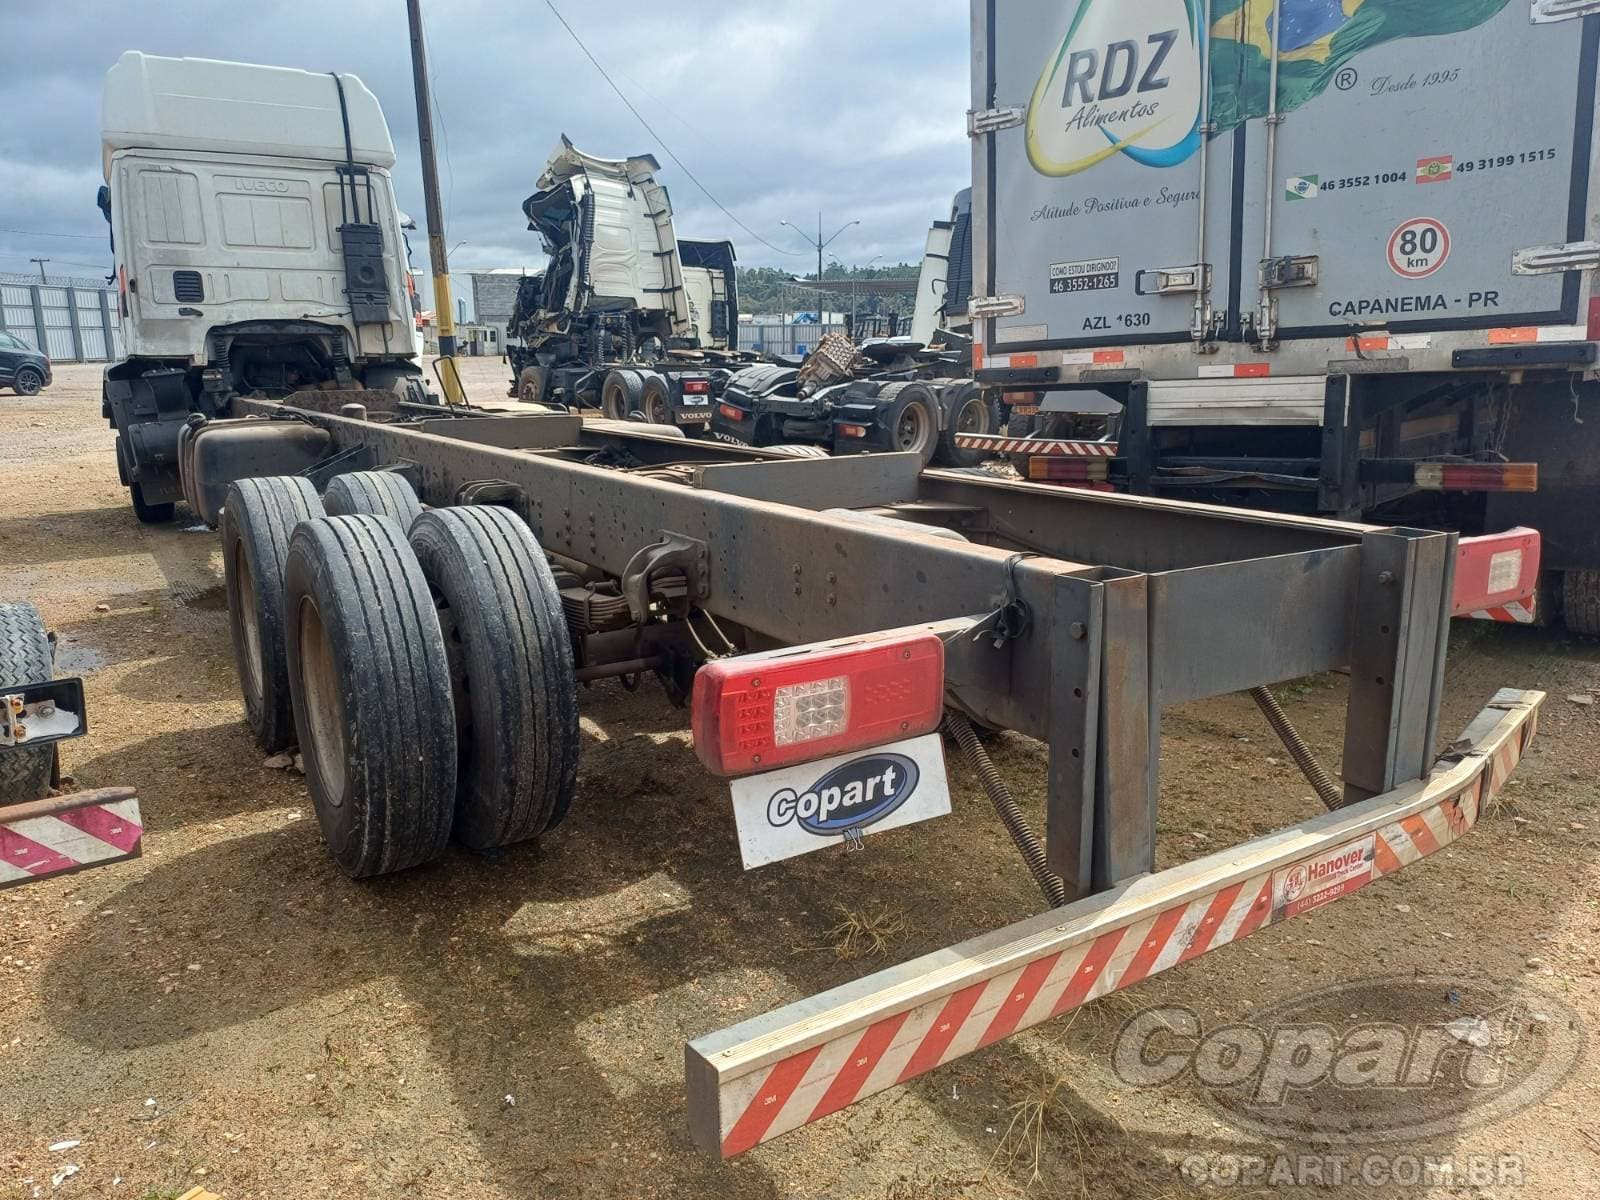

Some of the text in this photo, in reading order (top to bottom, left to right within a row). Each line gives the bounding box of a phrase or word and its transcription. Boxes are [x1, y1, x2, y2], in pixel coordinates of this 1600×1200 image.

[1061, 29, 1179, 108] RDZ
[1369, 67, 1461, 97] Desde 1995
[1064, 101, 1159, 133] Alimentos
[1456, 148, 1556, 173] 49 3199 1515
[234, 179, 289, 193] IVECO
[1320, 171, 1407, 192] 46 3552 1004
[1030, 201, 1081, 222] Atitude
[1084, 196, 1143, 214] Positiva
[1143, 196, 1151, 206] e
[1399, 227, 1437, 256] 80
[1052, 260, 1117, 277] COMO ESTOU DIRIGINDO?
[1406, 256, 1429, 269] km
[1053, 275, 1116, 292] 46 3552-1265
[1328, 293, 1448, 317] CAPANEMA
[1468, 290, 1499, 308] PR
[1082, 316, 1111, 331] AZL
[680, 412, 713, 420] VOLVO
[767, 763, 897, 828] Copart
[1308, 848, 1364, 882] Hanover
[856, 1056, 868, 1068] 3M
[763, 1094, 777, 1106] 3M
